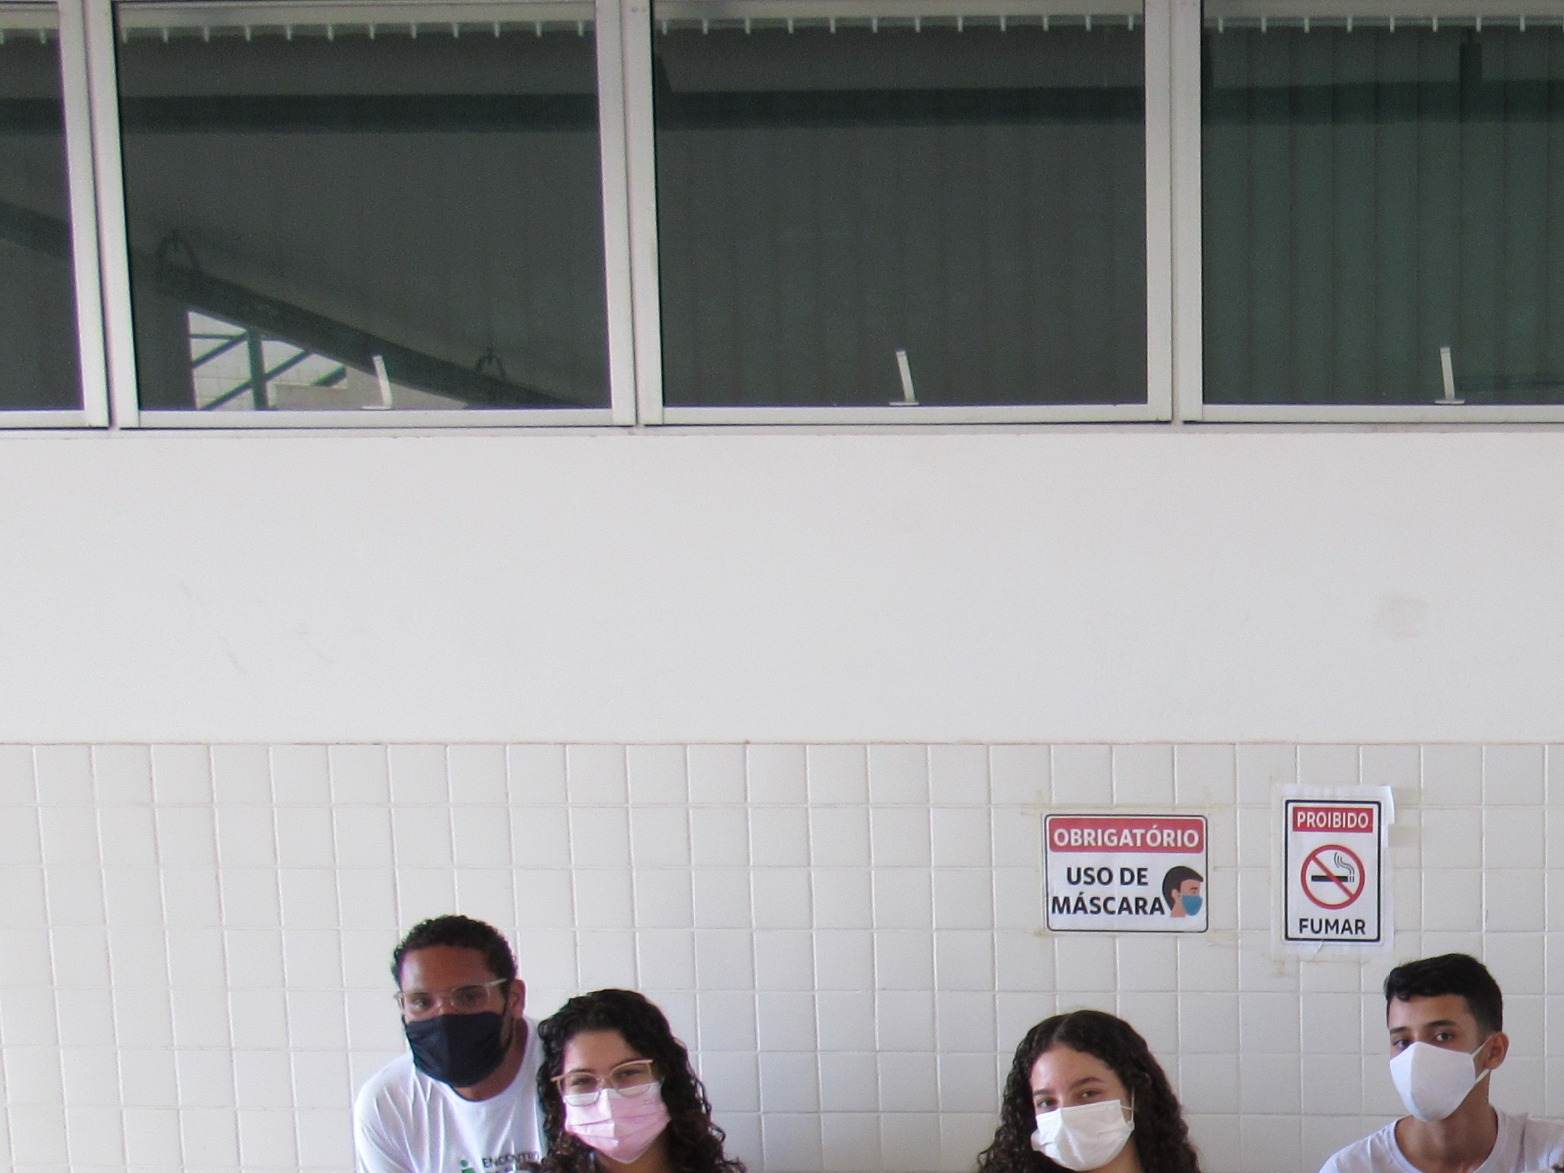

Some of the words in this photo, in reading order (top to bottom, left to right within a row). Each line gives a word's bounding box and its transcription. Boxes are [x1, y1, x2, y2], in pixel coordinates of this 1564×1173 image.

[1297, 811, 1369, 829] PROIBIDO
[1053, 824, 1199, 848] OBRIGATÓRIO
[1066, 867, 1113, 887] USO
[1119, 867, 1149, 887] DE
[1051, 892, 1166, 916] MÁSCARA
[1298, 918, 1366, 935] FUMAR
